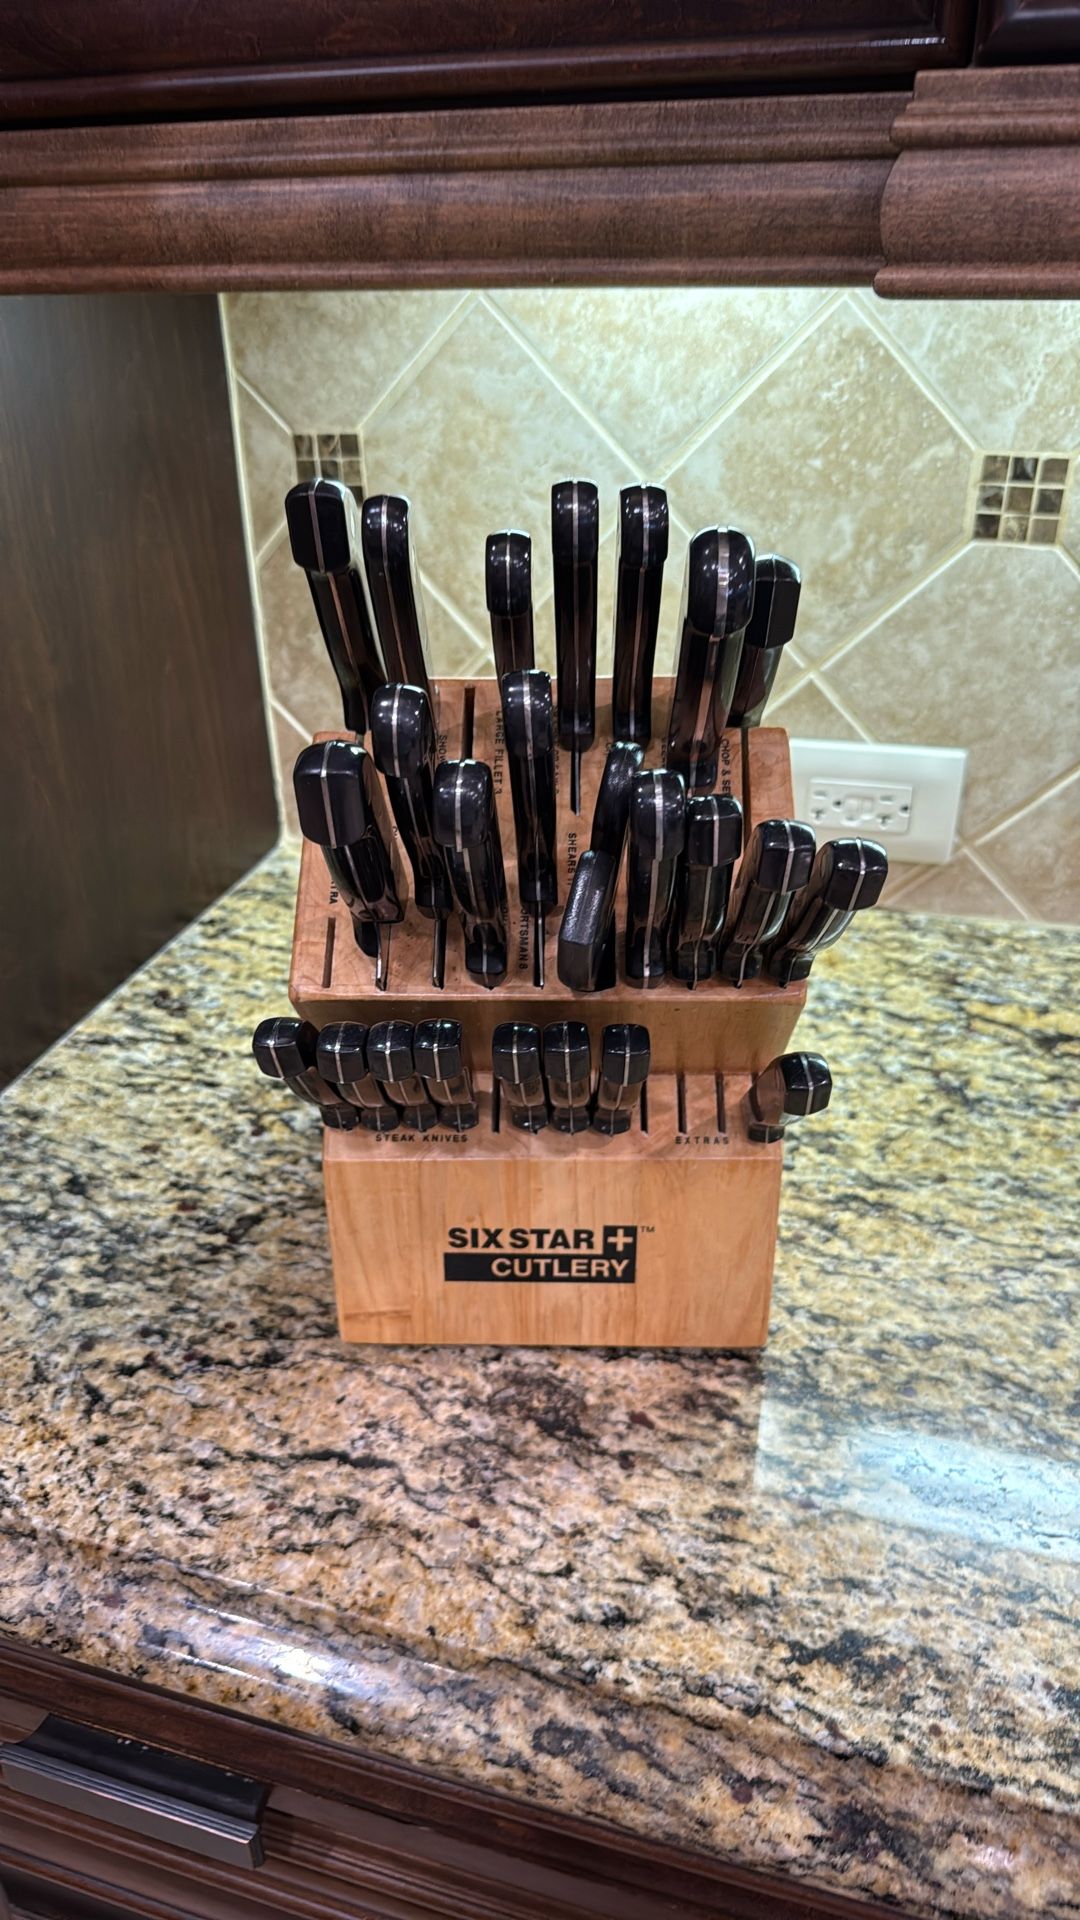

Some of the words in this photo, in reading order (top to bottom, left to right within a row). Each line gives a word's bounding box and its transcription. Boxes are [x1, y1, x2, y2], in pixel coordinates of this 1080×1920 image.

[495, 710, 504, 744] LARGE
[720, 739, 730, 766] CHOP
[493, 749, 504, 785] FILLET
[567, 832, 577, 873] SHEARS
[375, 1133, 415, 1142] STEAK
[422, 1134, 468, 1142] KNIVES
[675, 1136, 729, 1144] EXTRAS
[447, 1227, 504, 1249] SIX
[508, 1228, 594, 1249] STAR
[490, 1257, 630, 1278] CUTLERY
